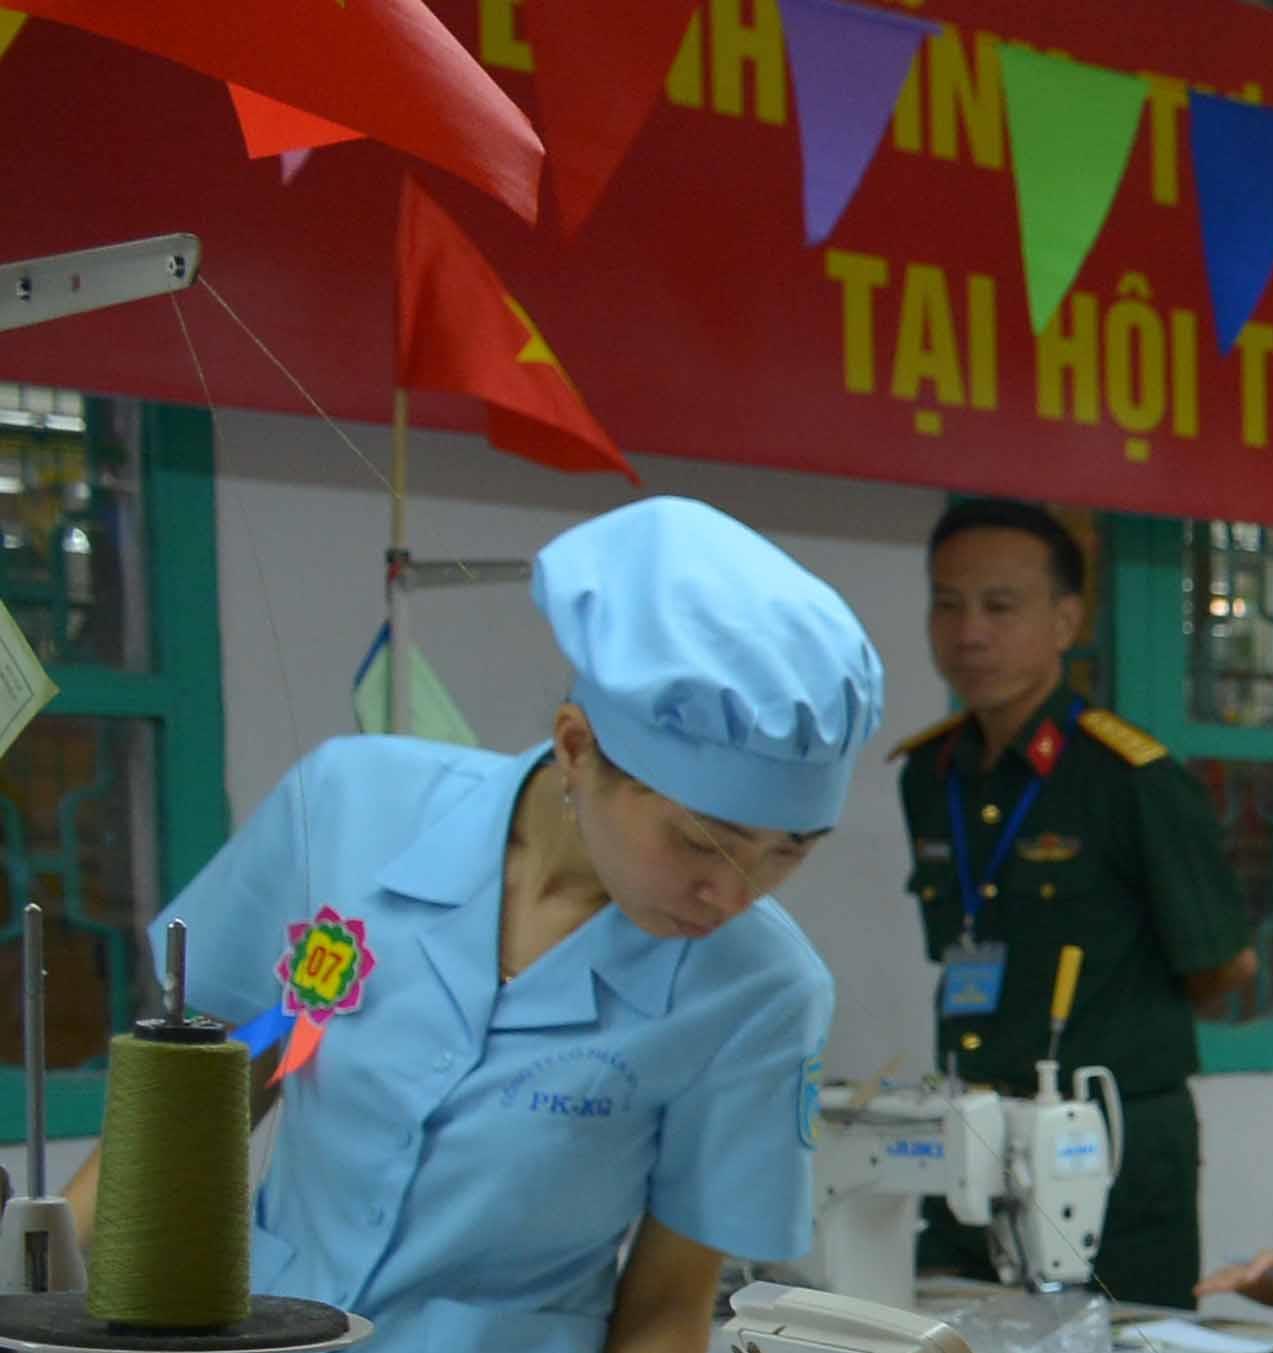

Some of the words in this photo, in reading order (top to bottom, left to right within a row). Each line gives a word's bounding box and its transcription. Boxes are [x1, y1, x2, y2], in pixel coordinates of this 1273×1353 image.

[826, 250, 998, 438] TẠI
[1035, 272, 1199, 463] HỘI
[308, 945, 343, 982] 07
